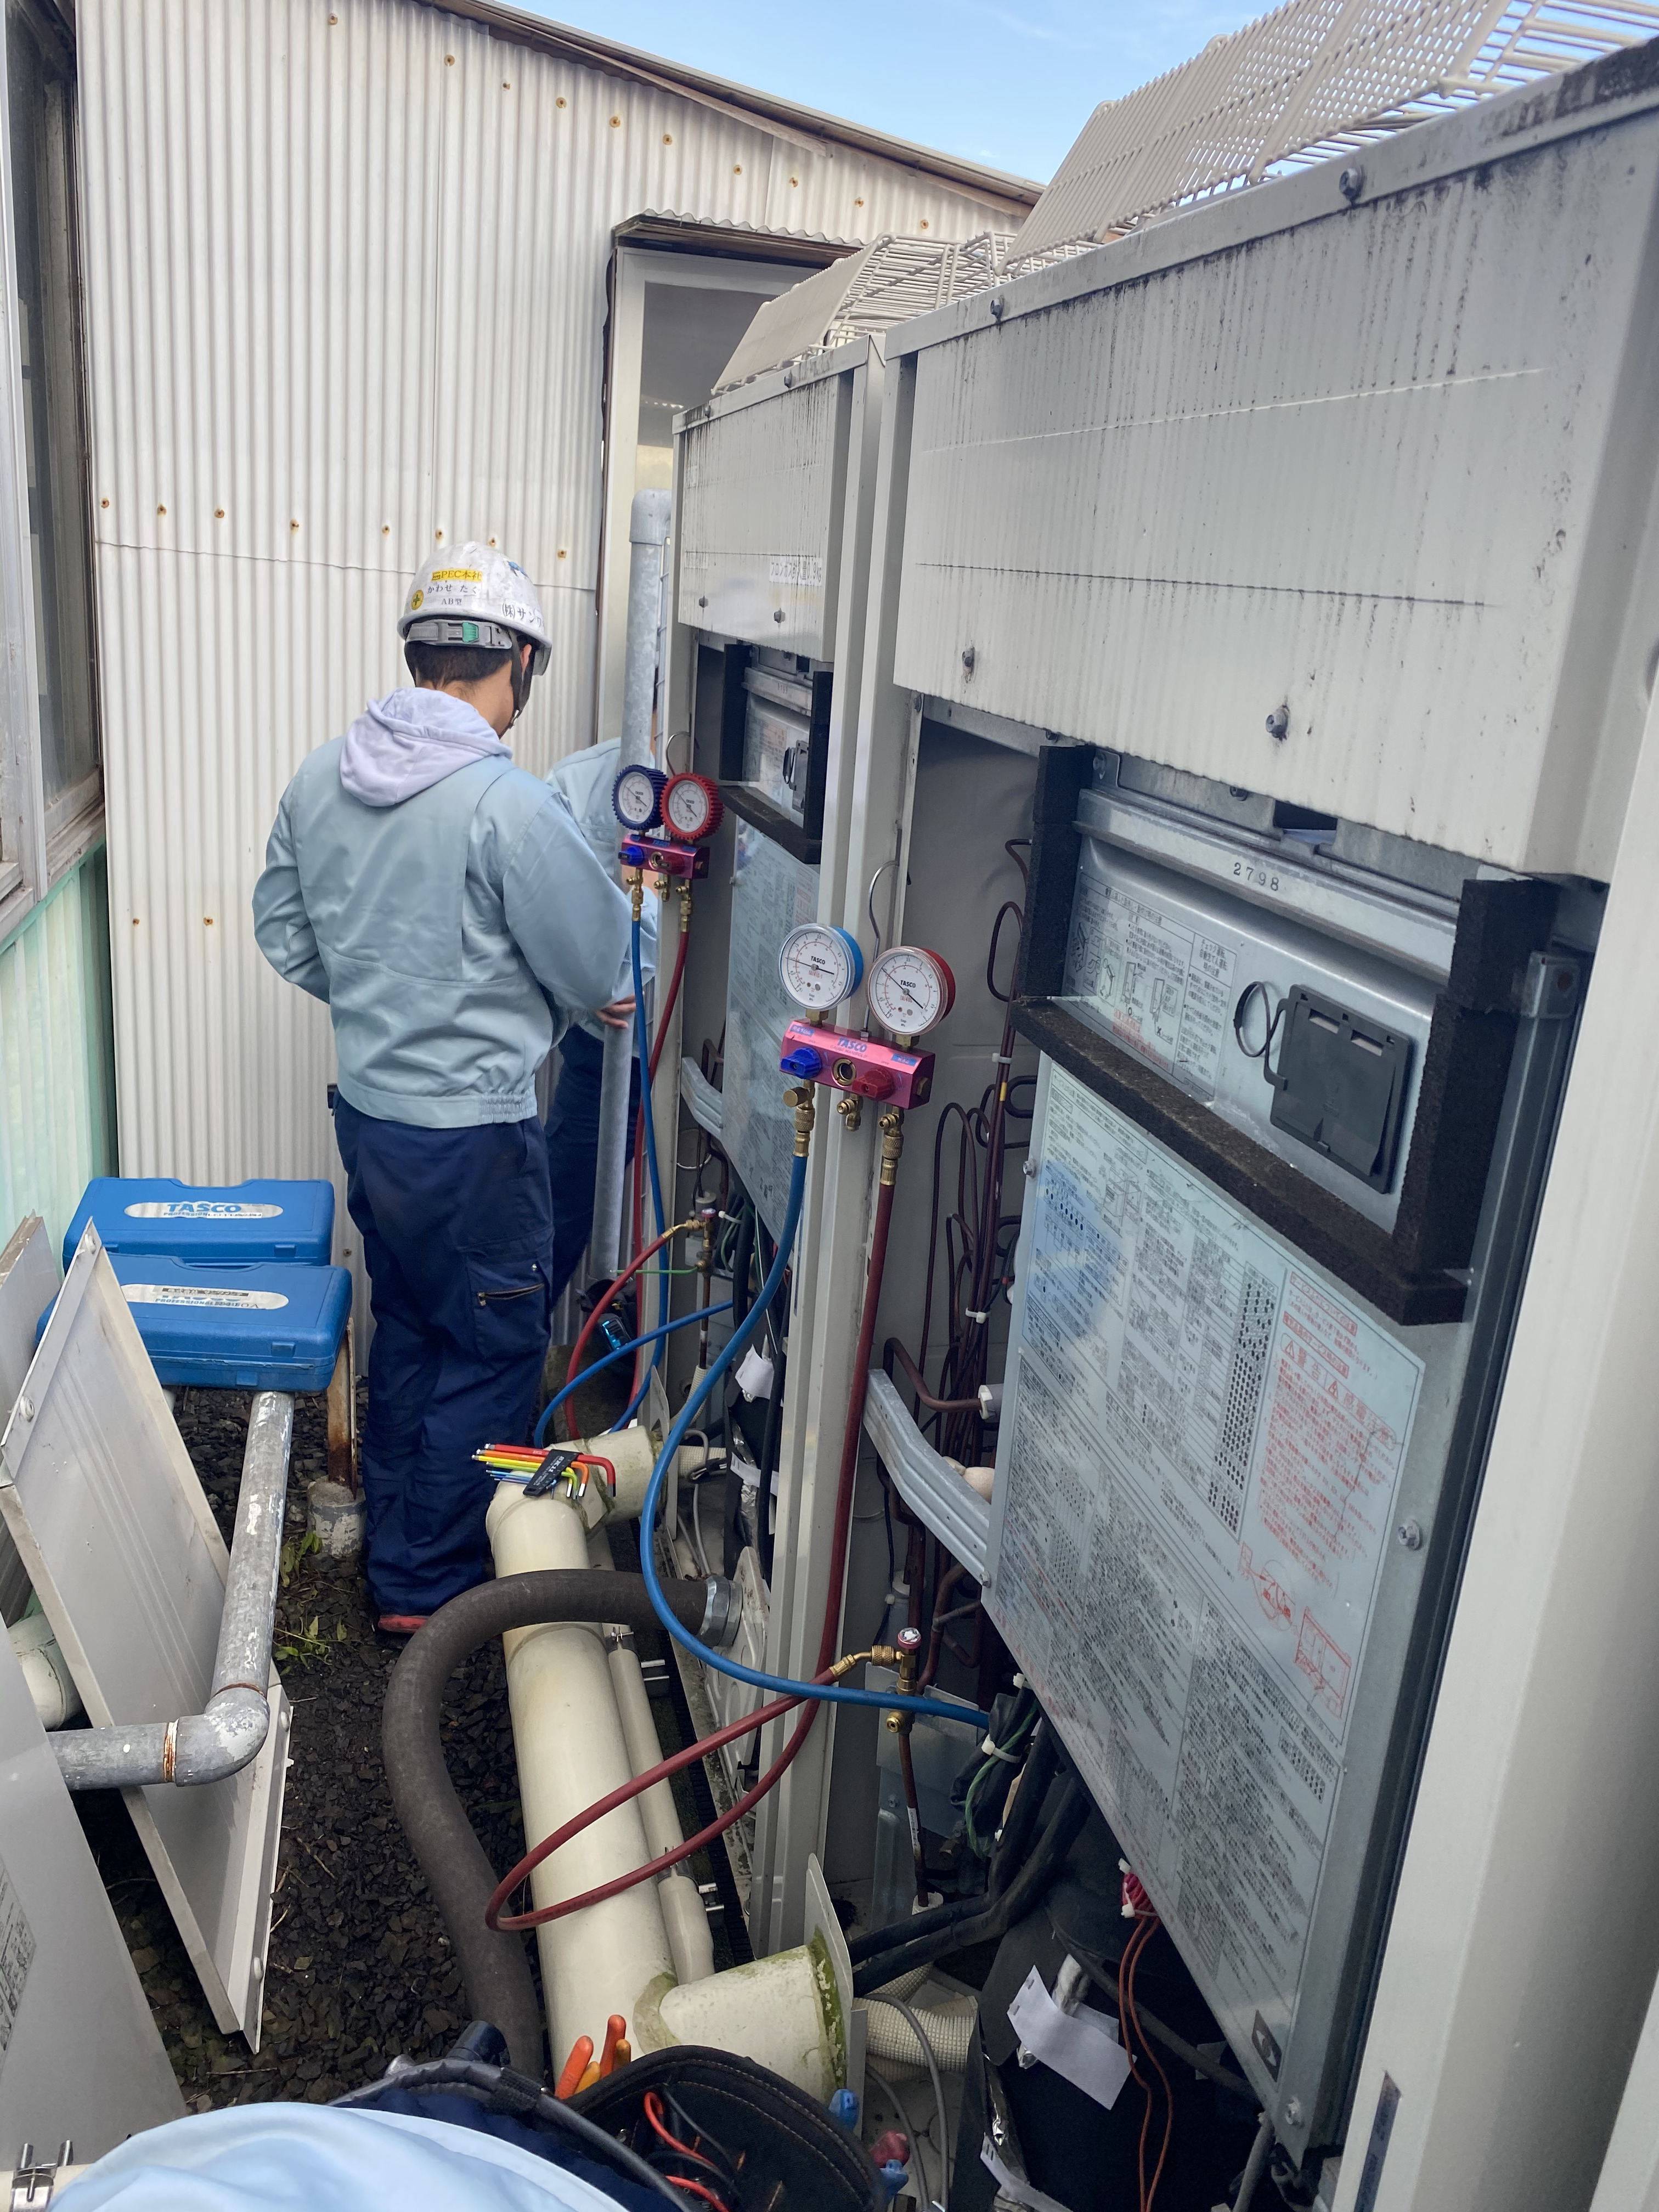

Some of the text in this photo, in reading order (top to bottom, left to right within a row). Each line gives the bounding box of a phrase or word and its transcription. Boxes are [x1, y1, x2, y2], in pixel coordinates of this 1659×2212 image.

[1233, 862, 1279, 891] 2798
[811, 956, 826, 965] TASCO
[900, 980, 916, 988] TASCO
[838, 1037, 867, 1053] TASCO
[167, 1202, 242, 1214] TASCO
